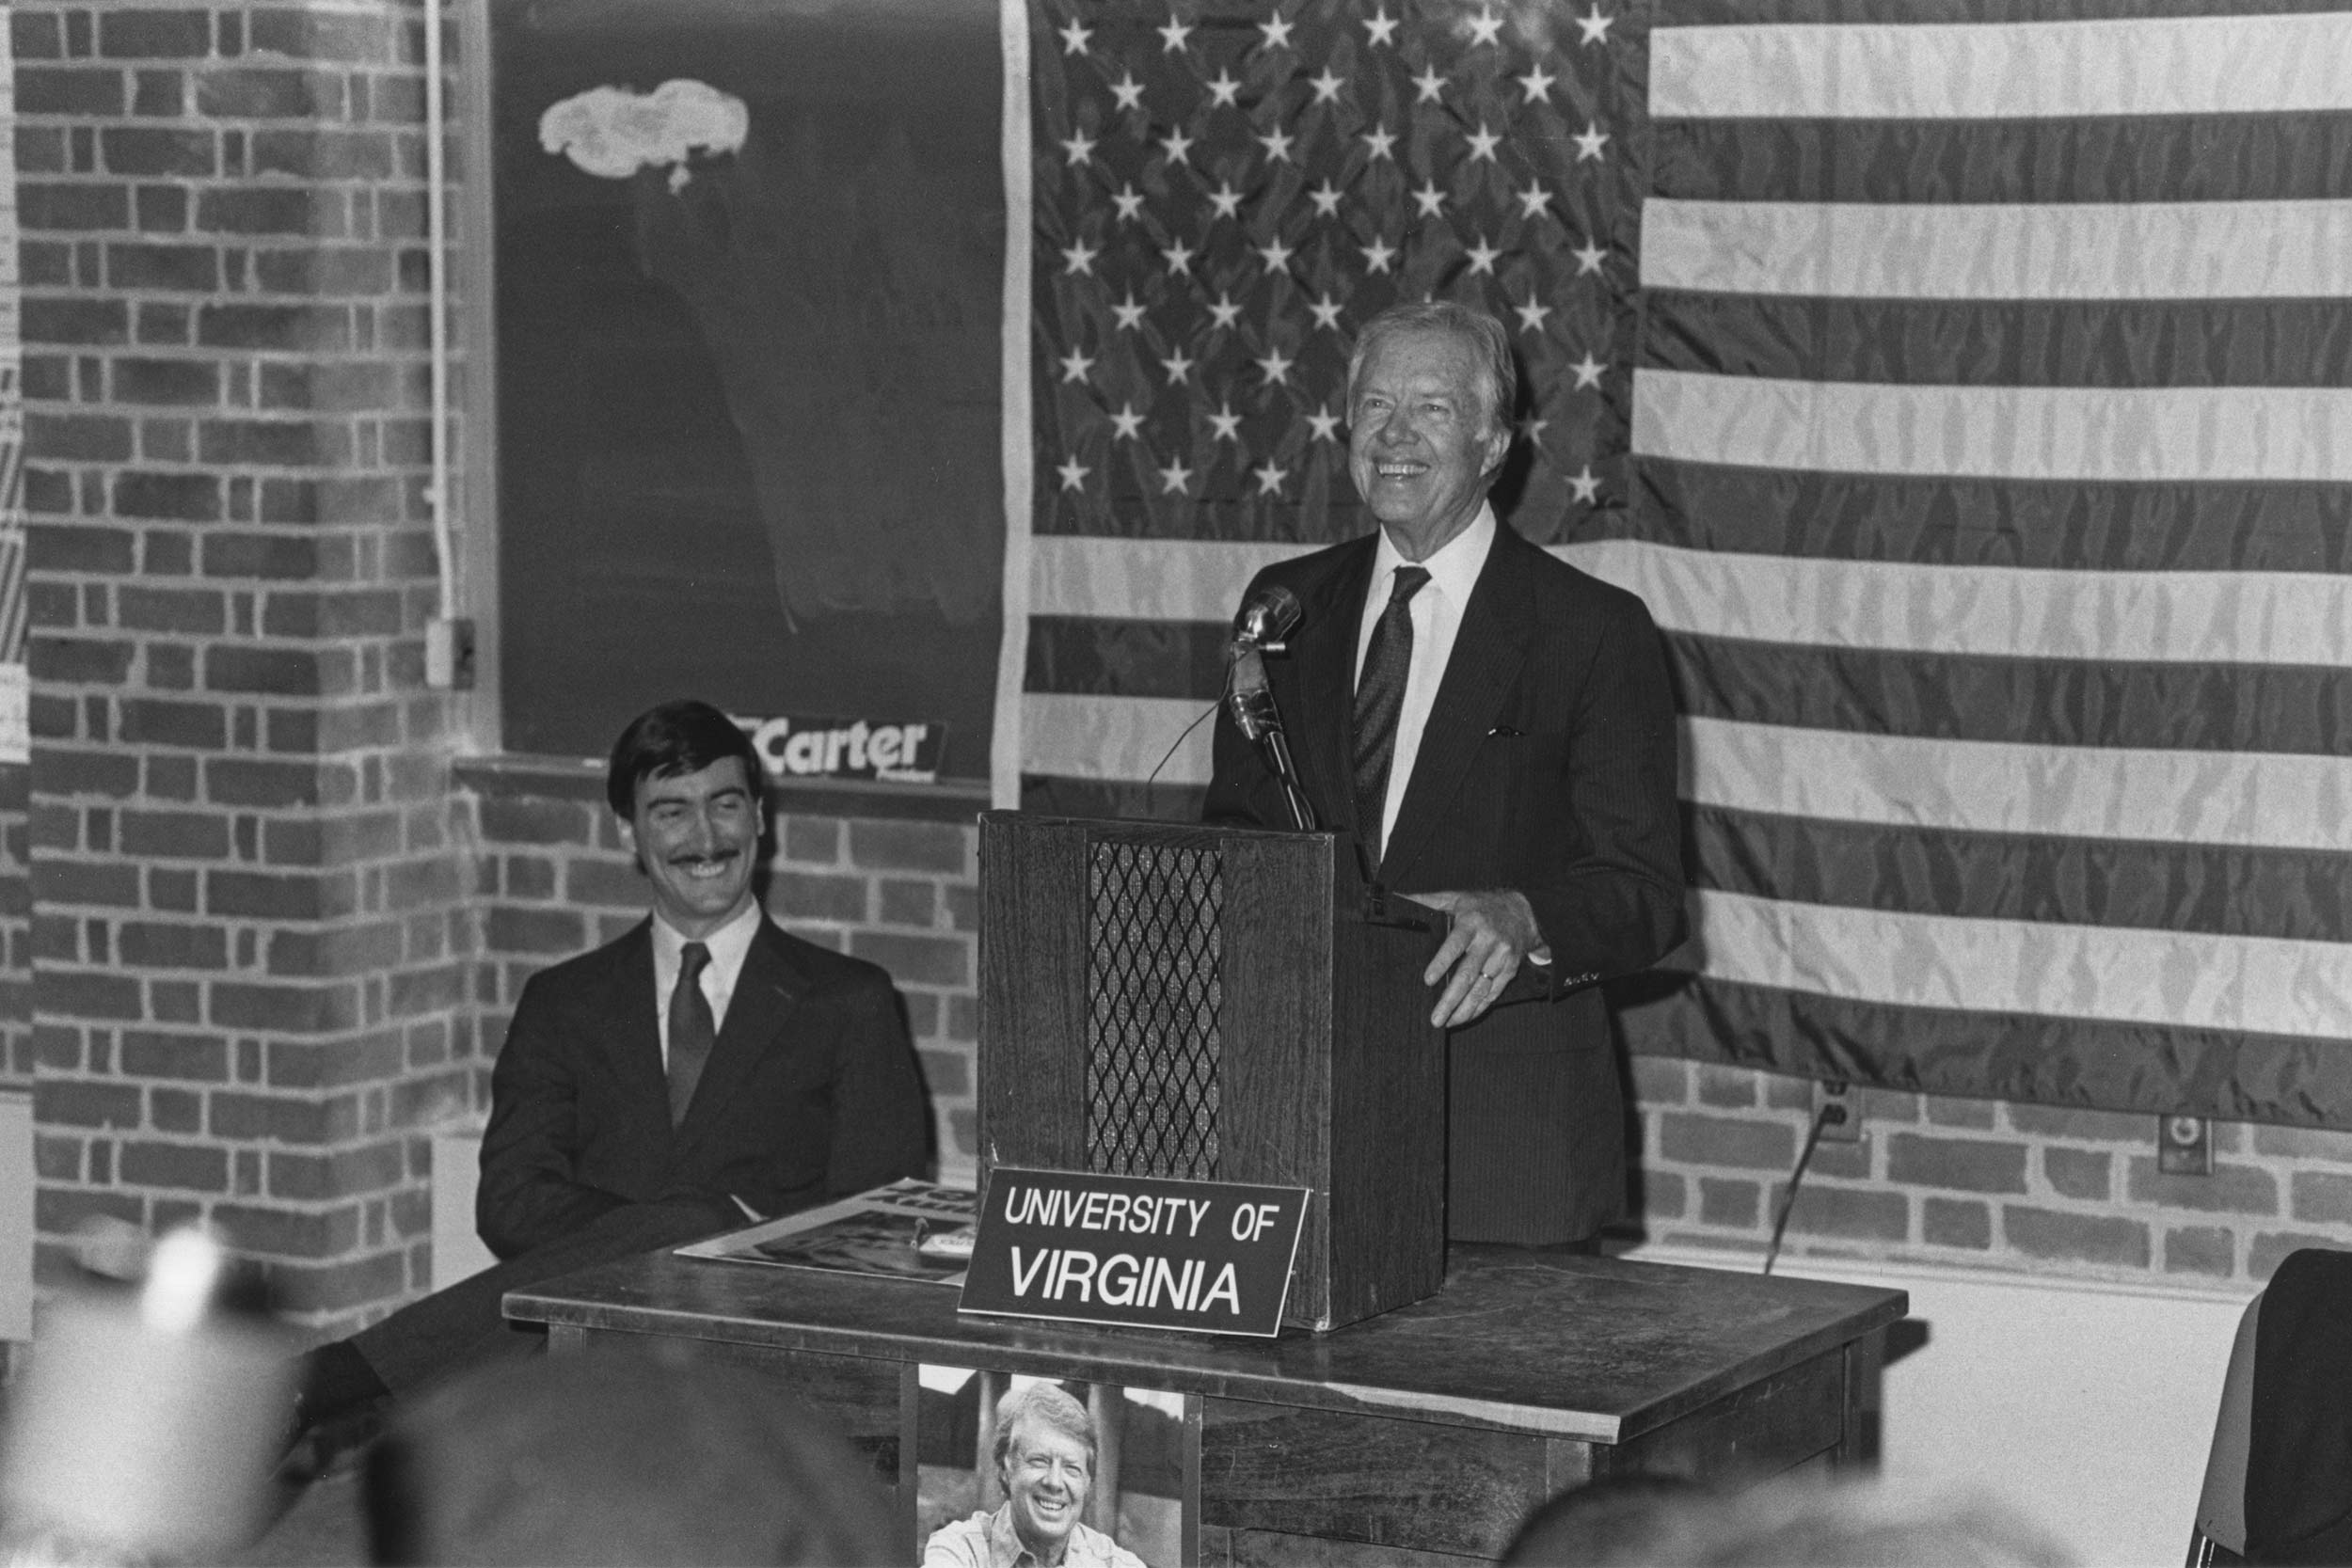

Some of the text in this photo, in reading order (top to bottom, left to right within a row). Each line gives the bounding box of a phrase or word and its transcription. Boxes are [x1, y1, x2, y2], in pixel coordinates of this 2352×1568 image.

[752, 717, 928, 774] Carter
[1005, 1186, 1211, 1237] UNIVERSITY
[1232, 1203, 1279, 1242] OF
[1010, 1245, 1240, 1314] VIRGINIA
